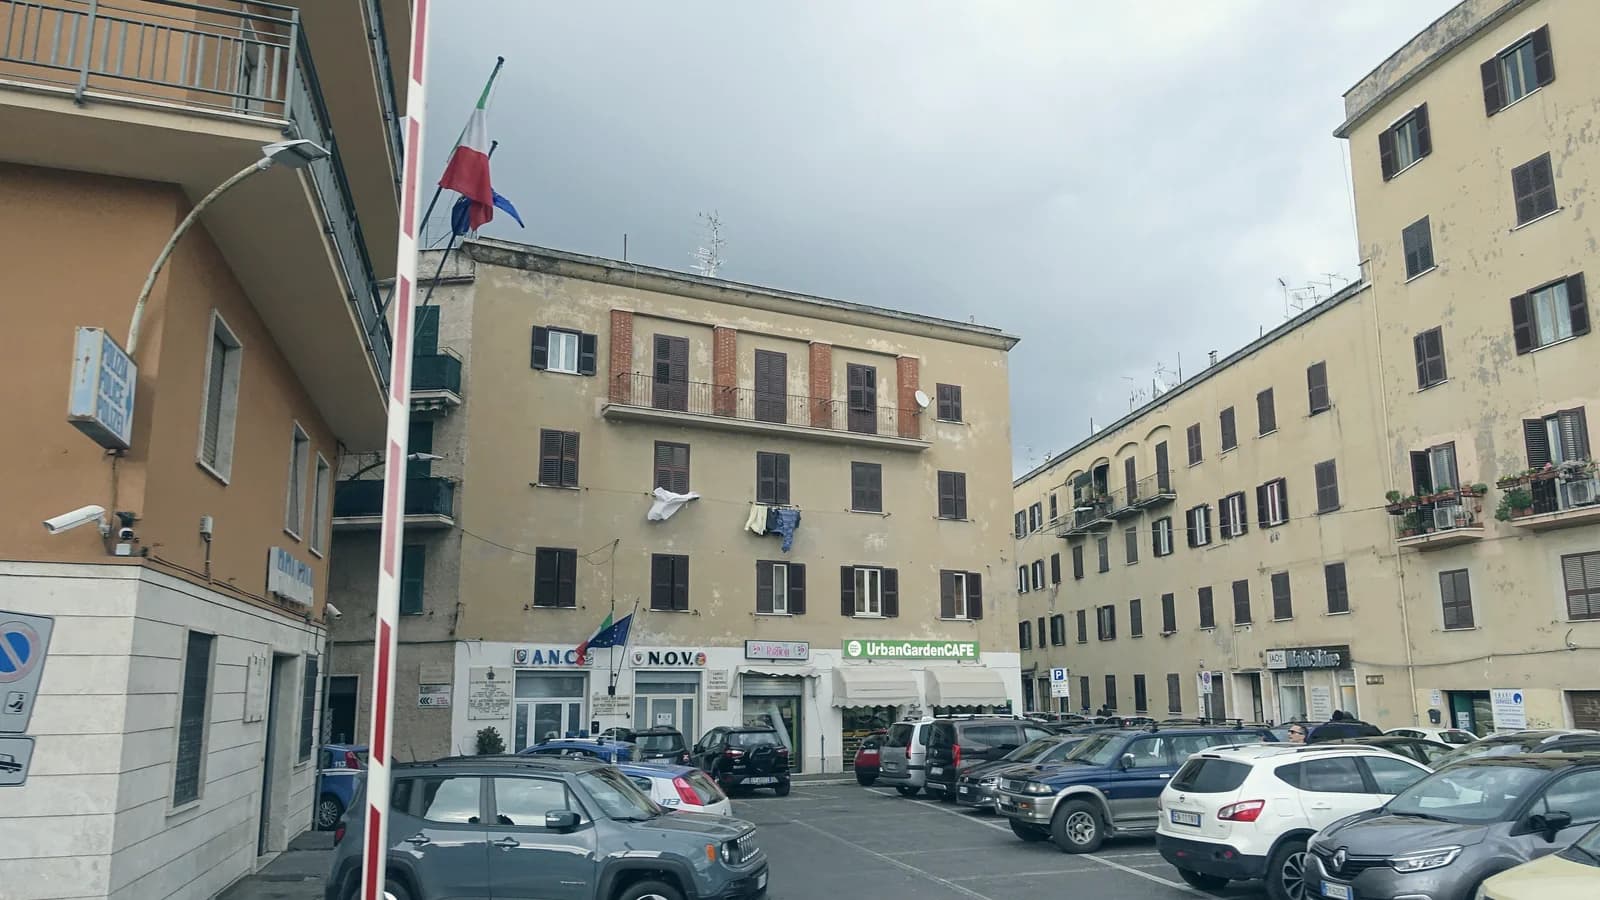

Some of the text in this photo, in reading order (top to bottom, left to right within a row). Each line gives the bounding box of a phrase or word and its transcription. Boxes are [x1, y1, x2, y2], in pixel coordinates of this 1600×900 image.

[100, 365, 125, 409] POLICE
[866, 642, 974, 657] UrbanGardenCAFE
[648, 651, 694, 665] N.O.V.
[335, 760, 346, 768] 113
[661, 798, 680, 806] 113
